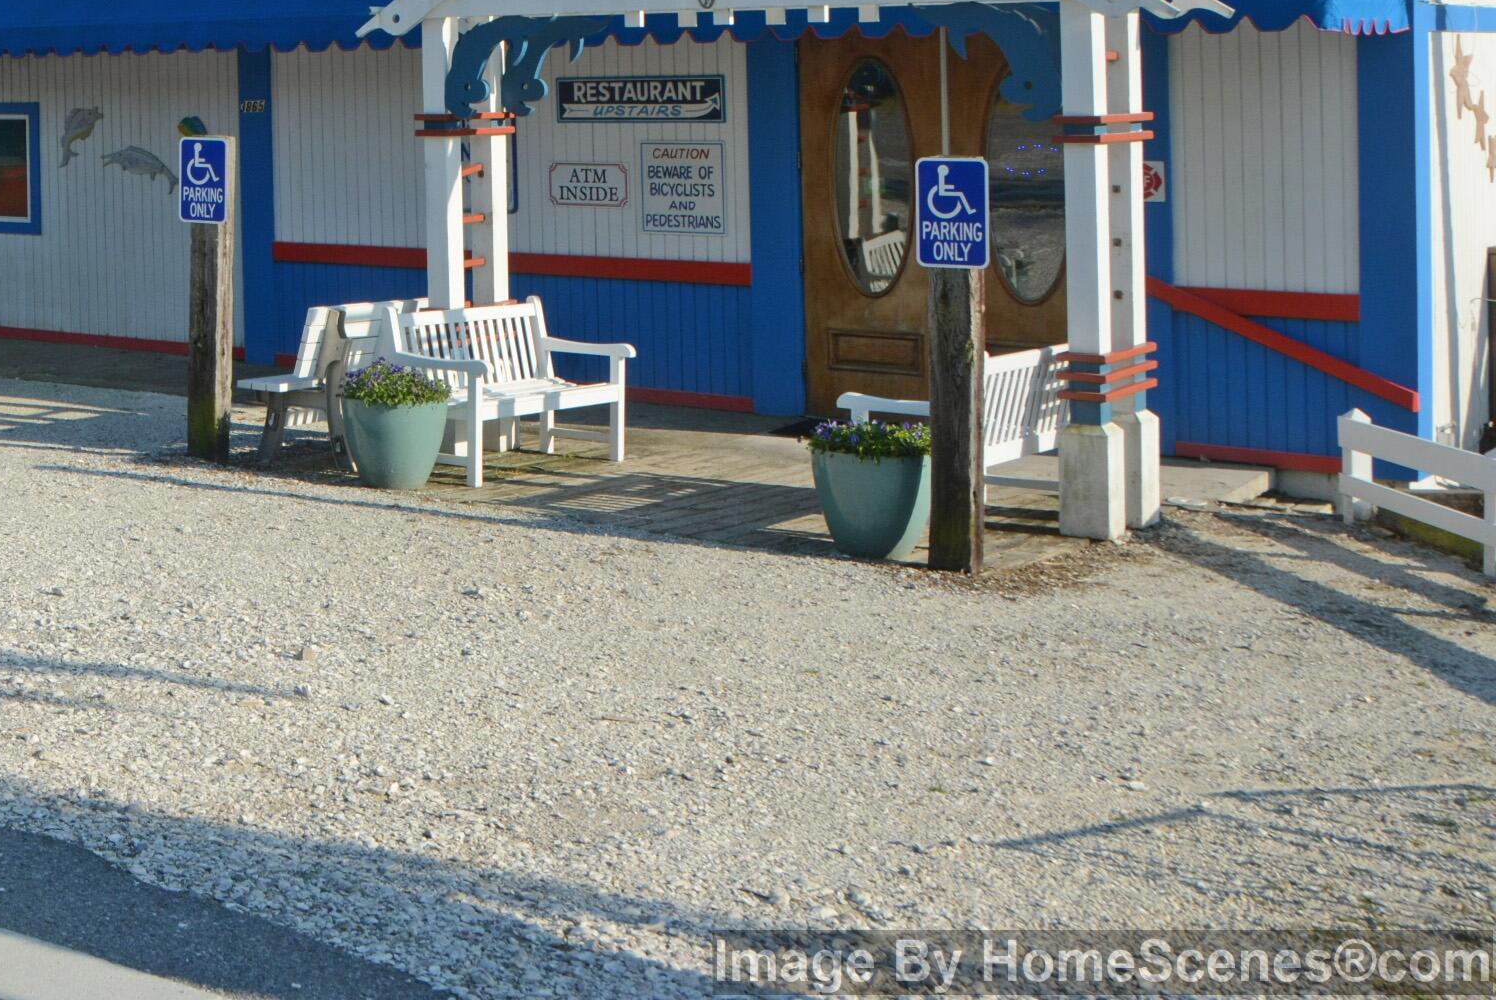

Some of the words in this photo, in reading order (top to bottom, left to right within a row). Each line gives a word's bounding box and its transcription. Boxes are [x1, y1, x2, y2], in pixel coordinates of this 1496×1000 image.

[573, 81, 705, 103] RESTAURANT
[593, 105, 682, 117] UPSTAIRS
[652, 148, 710, 160] CAUTION
[569, 168, 607, 184] ATM
[647, 165, 693, 180] BEWARE
[698, 166, 714, 180] OF
[183, 186, 223, 203] PARKING
[559, 185, 619, 202] INSIDE
[650, 182, 715, 197] BICYCLISTS
[190, 202, 216, 218] ONLY
[668, 201, 696, 211] AND
[645, 214, 722, 230] PEDESTRIANS
[922, 221, 983, 242] PARKING
[933, 241, 972, 262] ONLY
